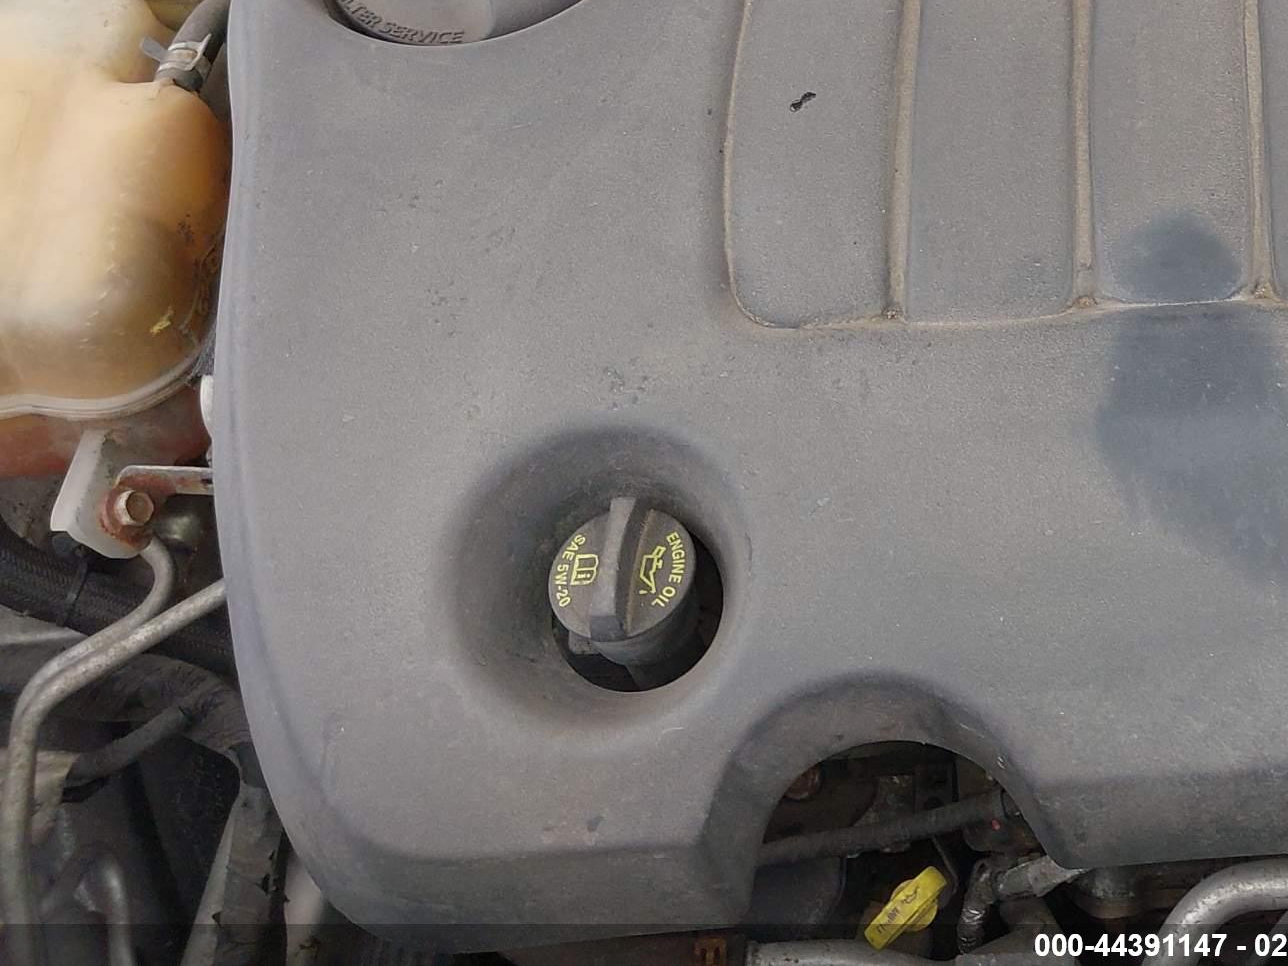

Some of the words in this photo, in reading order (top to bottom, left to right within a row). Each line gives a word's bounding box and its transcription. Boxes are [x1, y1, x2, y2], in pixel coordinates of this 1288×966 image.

[379, 22, 465, 44] SERVICE
[561, 534, 586, 561] SAE
[666, 532, 686, 584] ENGINE
[553, 564, 572, 608] 5W-20
[651, 586, 677, 608] OIL
